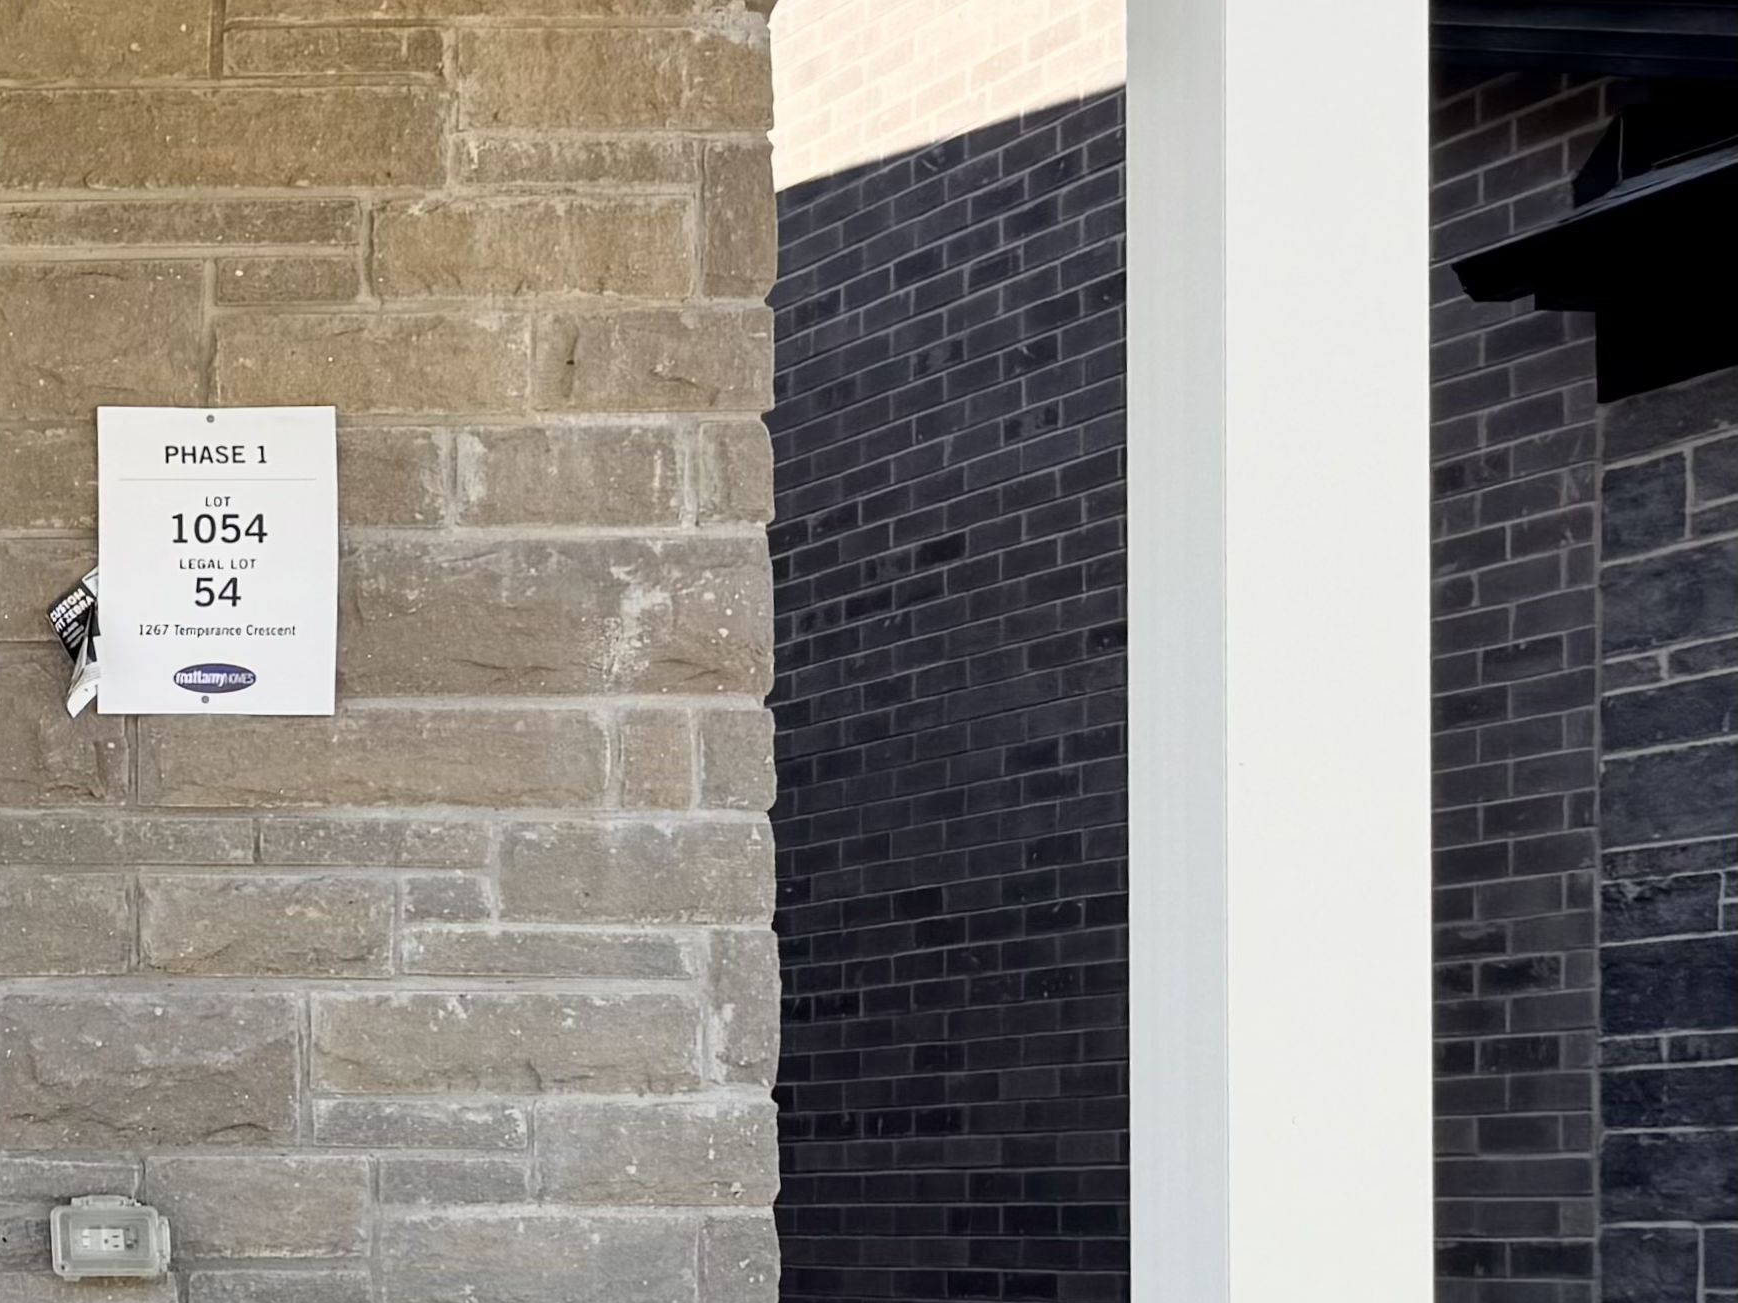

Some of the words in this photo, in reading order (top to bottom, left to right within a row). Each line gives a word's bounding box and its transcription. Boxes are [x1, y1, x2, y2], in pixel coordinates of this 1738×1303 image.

[164, 445, 246, 464] PHASE
[257, 445, 267, 464] 1
[204, 496, 231, 507] LOT
[172, 513, 268, 543] 1054
[179, 558, 224, 569] LEGAL
[230, 558, 256, 569] LOT
[195, 577, 241, 607] 54
[50, 587, 86, 622] CUSTOM
[64, 595, 94, 624] ZEBRA
[139, 624, 169, 636] 1267
[174, 624, 242, 638] Temperance
[246, 624, 296, 636] Crescent
